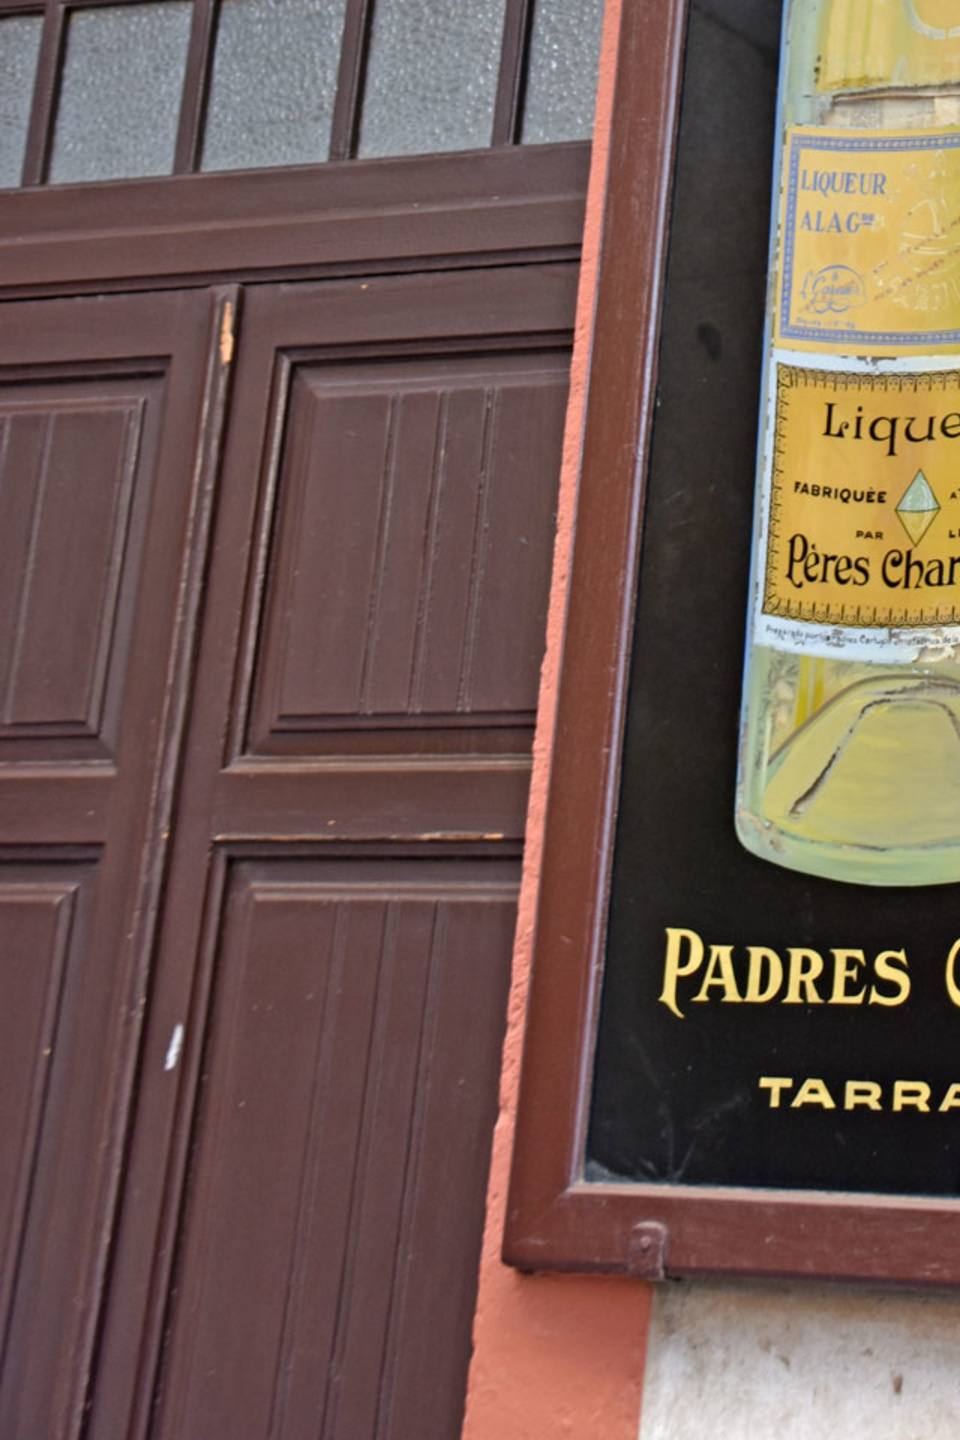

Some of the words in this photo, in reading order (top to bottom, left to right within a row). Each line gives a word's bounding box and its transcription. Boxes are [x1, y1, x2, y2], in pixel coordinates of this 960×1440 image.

[801, 169, 887, 198] LIQUEUR
[856, 530, 884, 540] PAR
[786, 533, 870, 588] Pères
[658, 927, 911, 1019] PADRES
